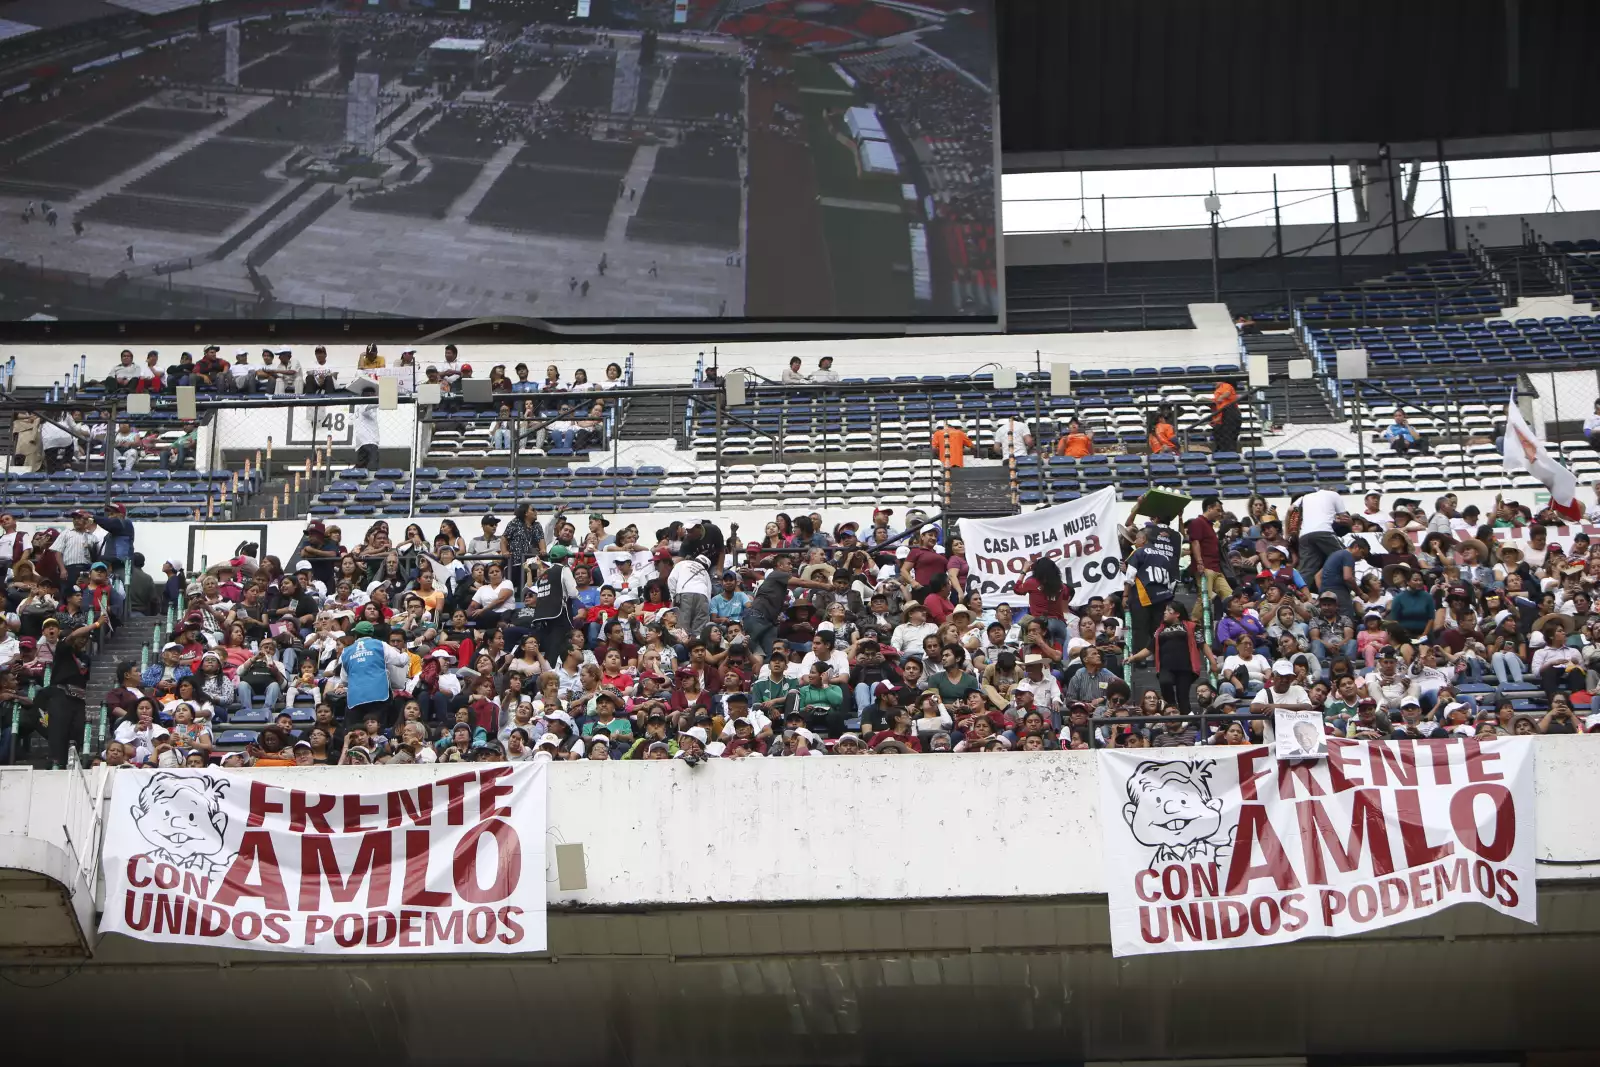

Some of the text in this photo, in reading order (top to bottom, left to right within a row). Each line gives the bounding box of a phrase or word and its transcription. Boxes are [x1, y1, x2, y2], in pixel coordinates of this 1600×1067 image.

[322, 413, 345, 431] 48
[975, 534, 1103, 575] morena
[983, 513, 1098, 553] CASA DE LA MUJER
[246, 766, 513, 833] FRENTE
[1237, 736, 1504, 801] FRENTE
[127, 818, 521, 911] CON AMLO
[1135, 783, 1516, 903] CON AMLO
[125, 889, 525, 948] UNIDOS PODEMOS
[1138, 858, 1519, 944] UNIDOS PODEMOS
